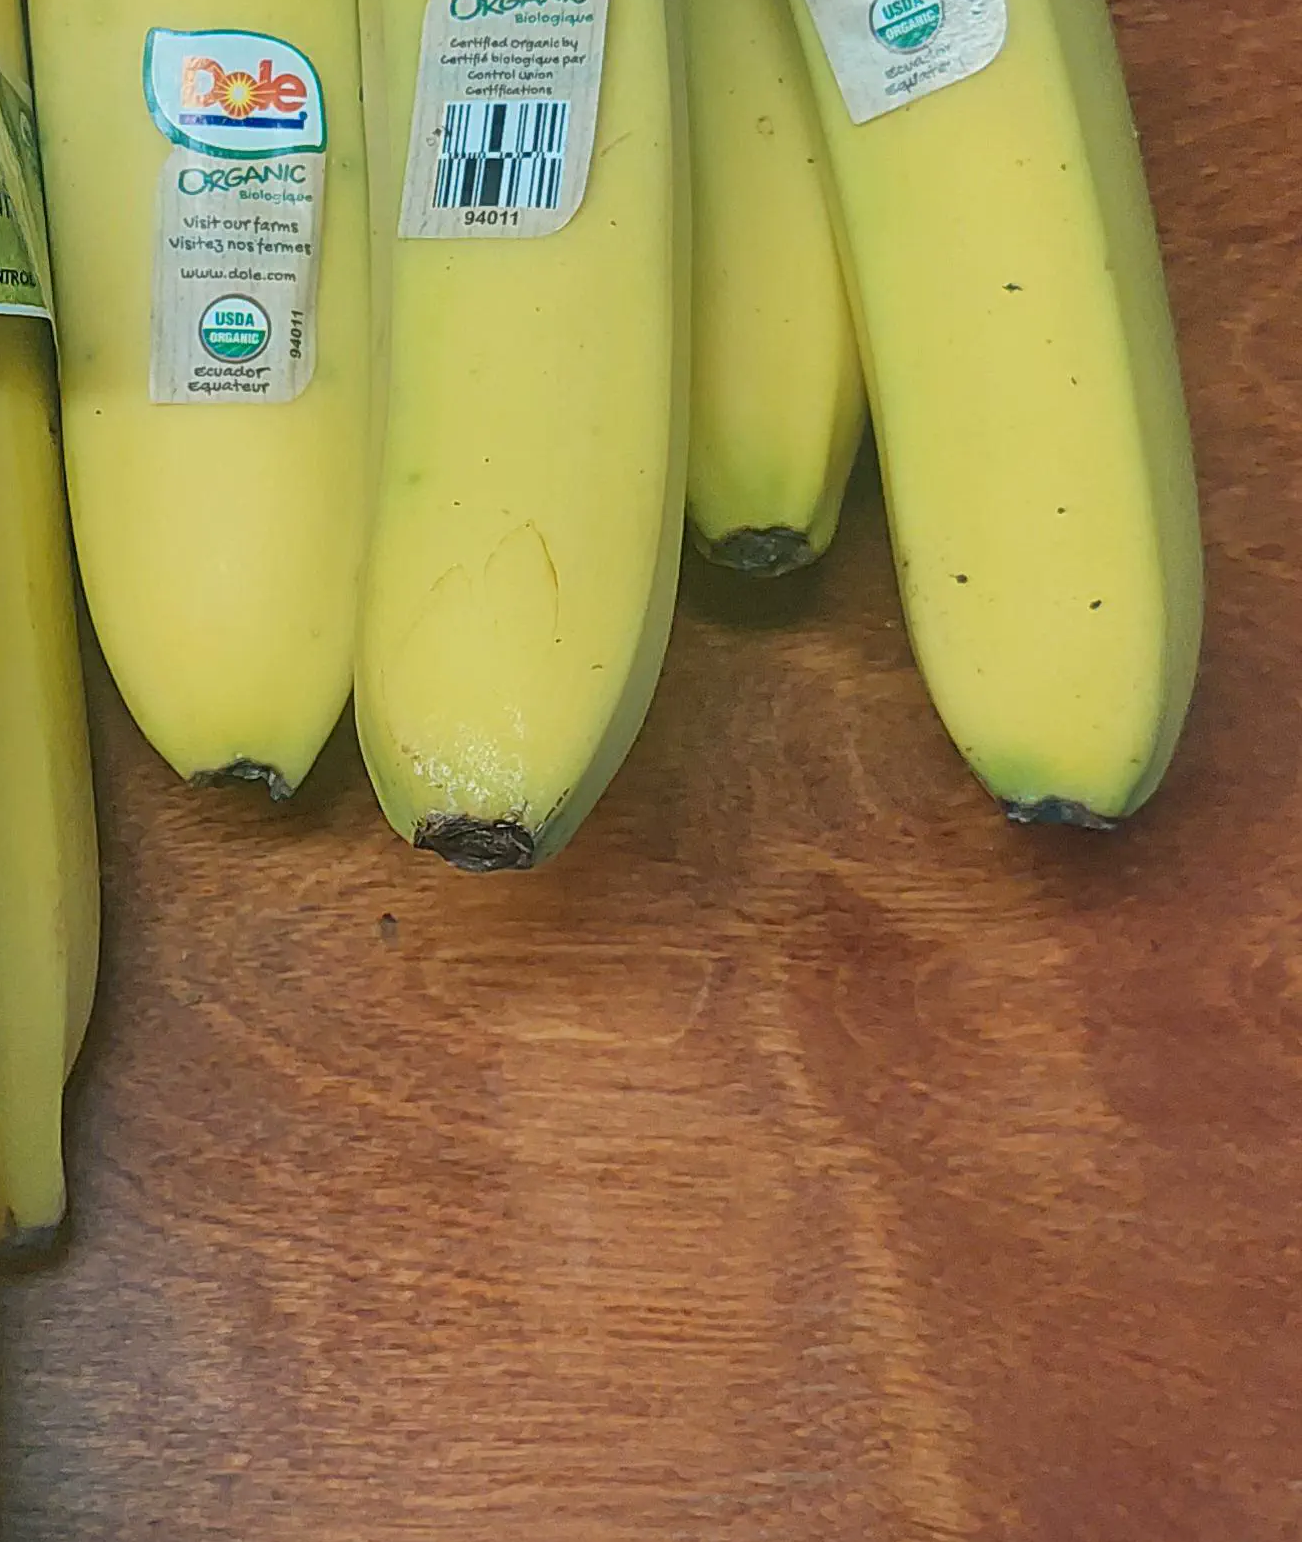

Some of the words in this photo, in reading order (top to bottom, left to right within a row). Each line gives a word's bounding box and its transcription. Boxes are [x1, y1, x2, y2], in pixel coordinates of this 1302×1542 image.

[514, 10, 594, 27] Biologique
[885, 8, 938, 41] ORGANIC
[450, 36, 508, 49] Certified
[561, 37, 579, 52] by
[491, 52, 560, 67] biologique
[562, 54, 586, 69] par
[467, 69, 516, 81] Control
[181, 56, 308, 119] Dole
[465, 85, 553, 98] Certifications
[178, 163, 307, 196] ORGANIC
[239, 189, 314, 204] Biologique
[223, 218, 252, 231] our
[254, 216, 299, 234] farms
[464, 211, 519, 226] 94011
[227, 239, 254, 251] nos
[257, 238, 313, 256] fermes
[180, 267, 297, 282] www.dole.com
[215, 311, 255, 327] USDA
[209, 330, 260, 345] ORGANIC
[290, 310, 304, 359] 94011
[194, 365, 271, 379] Ecuador
[187, 379, 271, 396] Equateur
